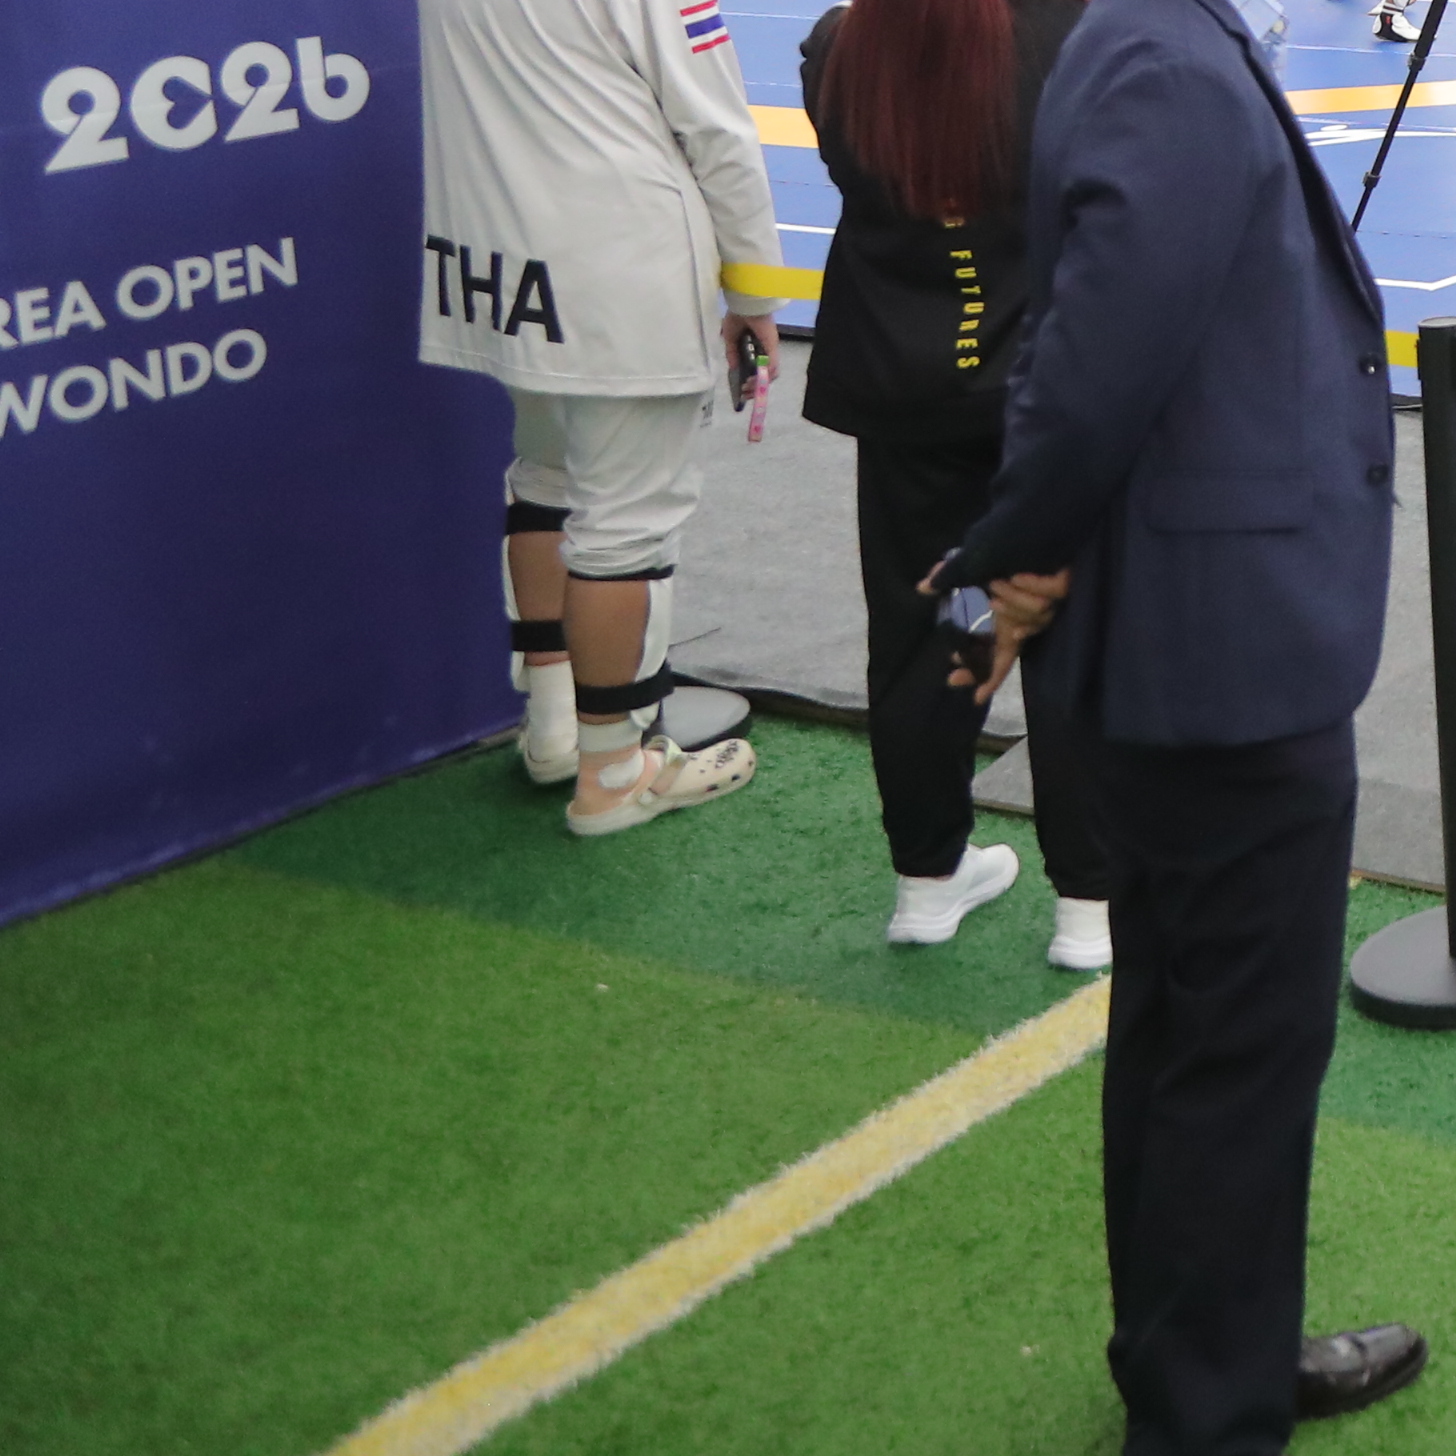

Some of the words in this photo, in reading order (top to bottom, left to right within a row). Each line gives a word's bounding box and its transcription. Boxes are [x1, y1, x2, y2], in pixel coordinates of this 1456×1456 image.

[116, 236, 299, 320] OPEN
[425, 234, 565, 345] THA
[950, 249, 985, 369] FUTURES
